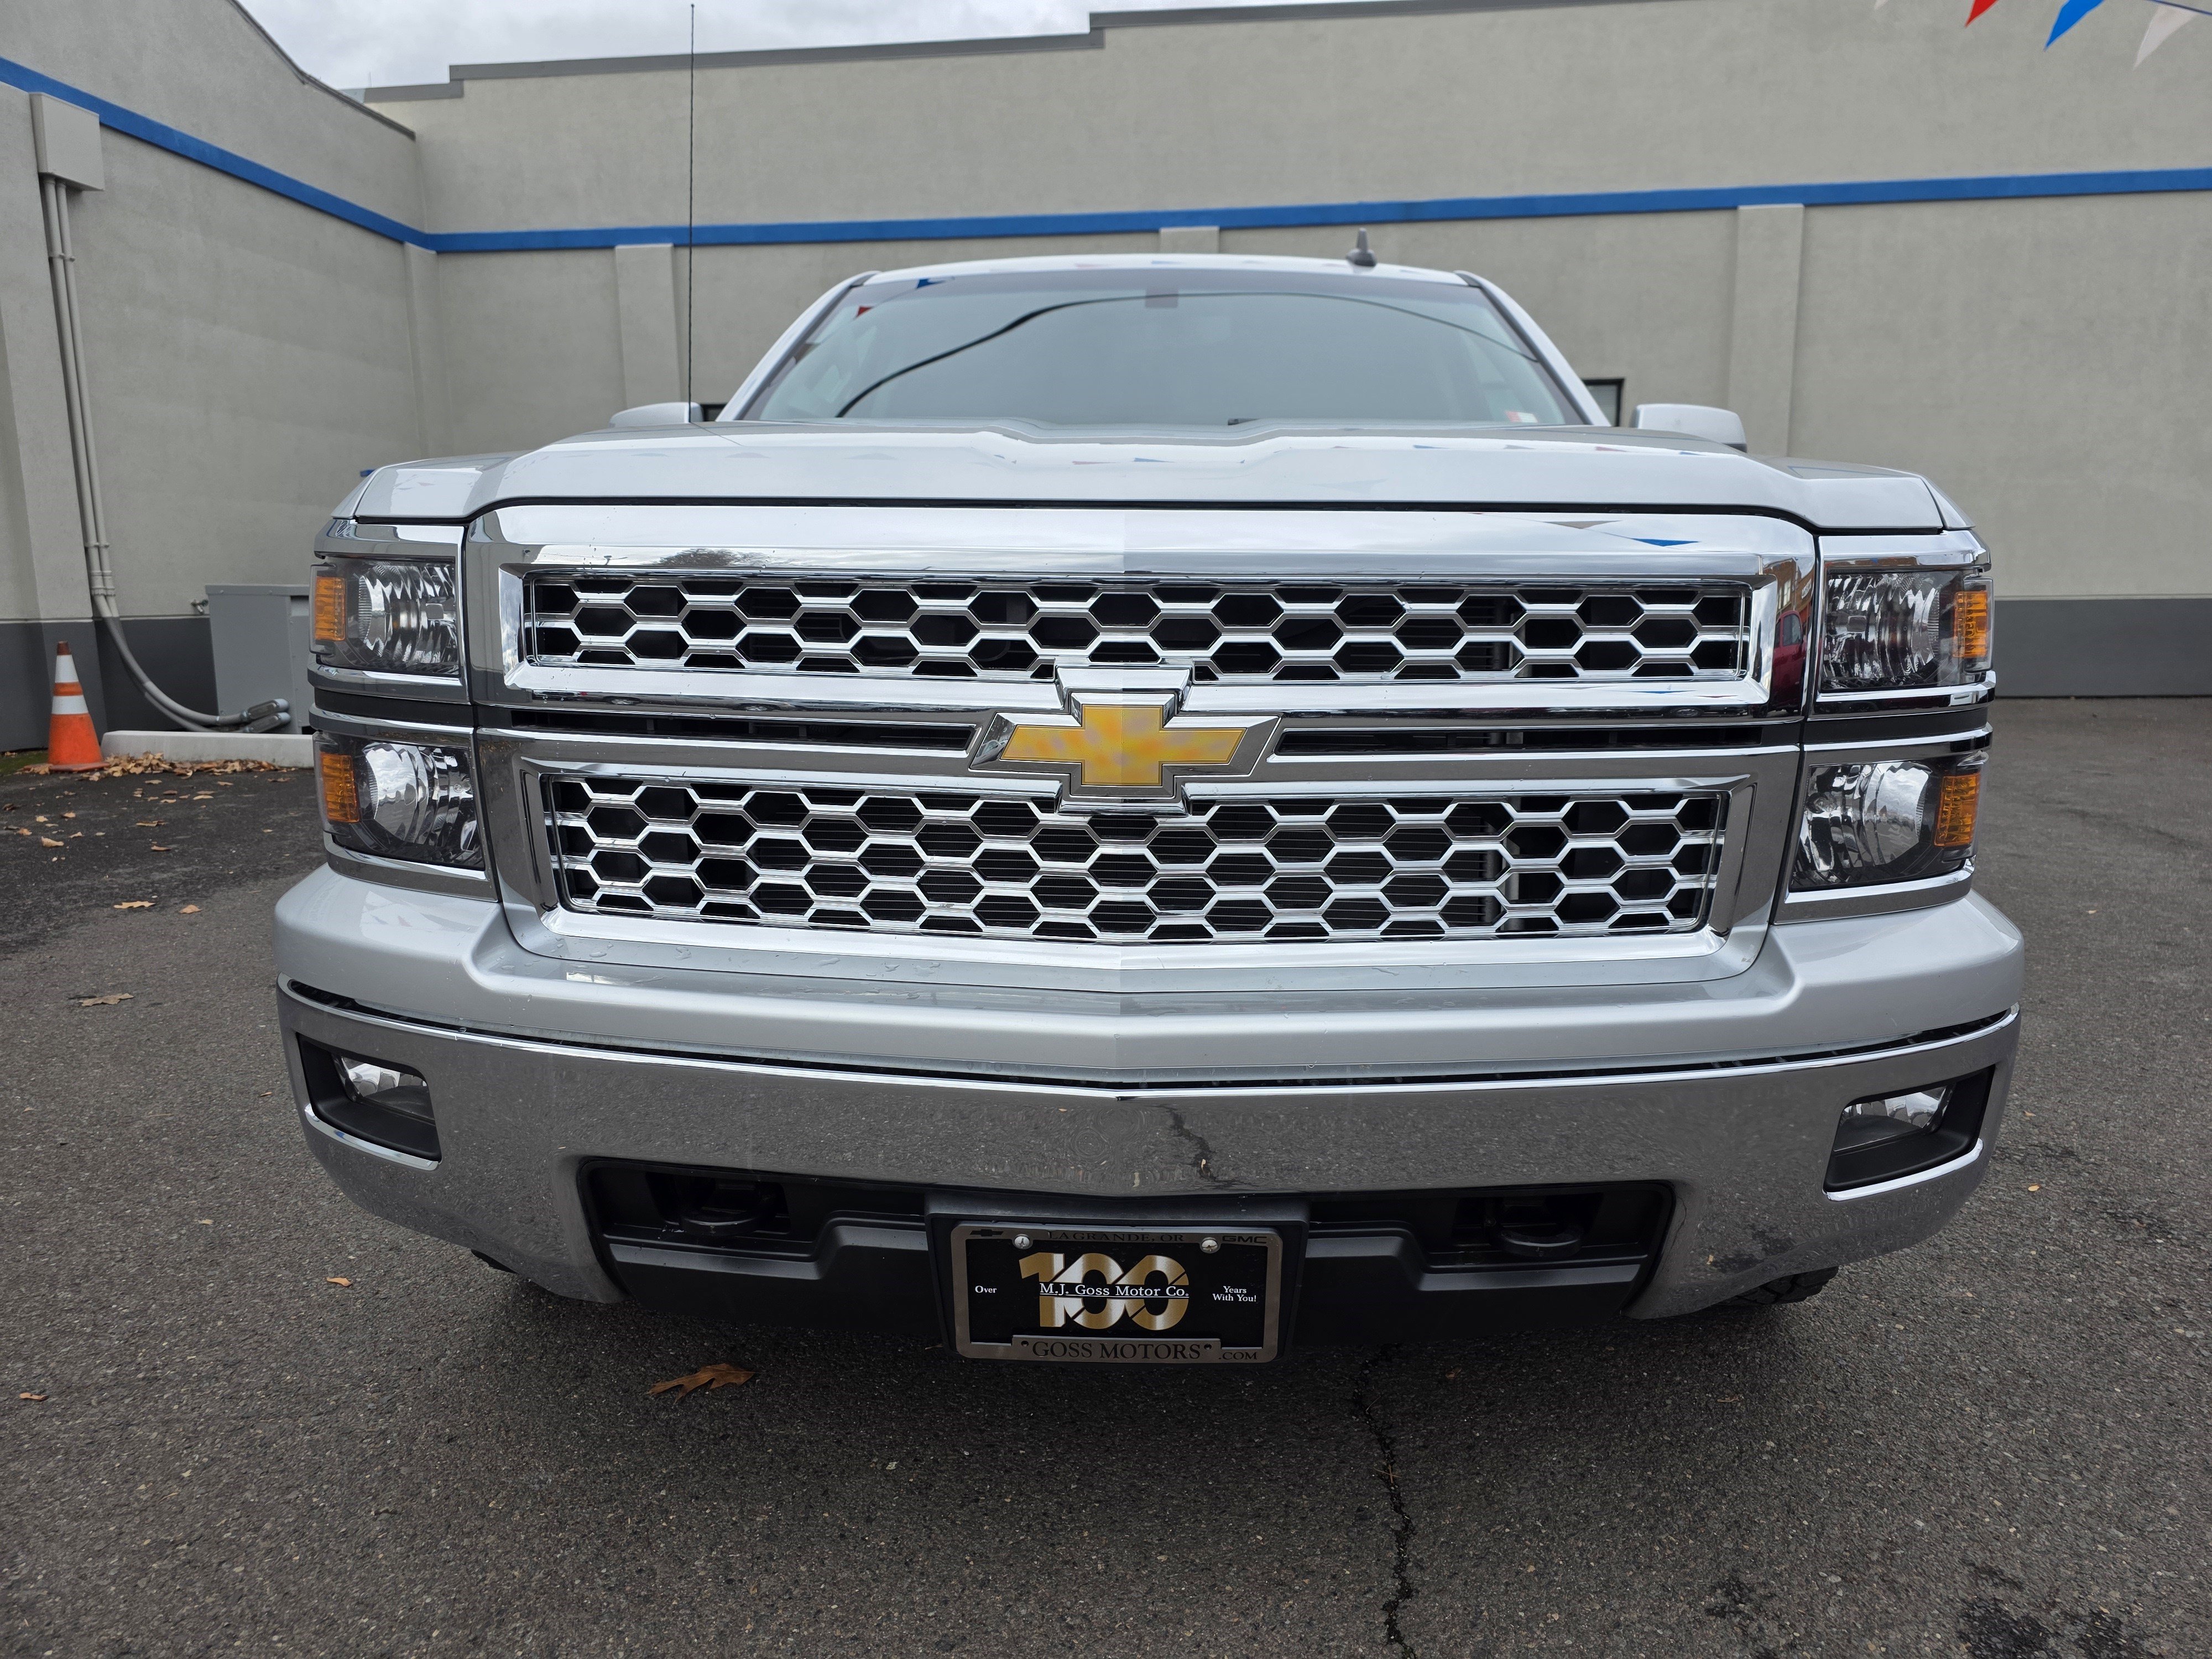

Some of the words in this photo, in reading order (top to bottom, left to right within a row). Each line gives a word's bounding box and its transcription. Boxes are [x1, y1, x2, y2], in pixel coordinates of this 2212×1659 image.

[1160, 1233, 1184, 1242] OR
[1222, 1235, 1267, 1244] GMC
[974, 1285, 997, 1293] Over
[1019, 1252, 1190, 1331] 100
[1039, 1283, 1070, 1296] M.J.
[1075, 1284, 1110, 1296] Goss
[1115, 1285, 1161, 1296] Motor
[1166, 1286, 1189, 1297] Co.
[1223, 1285, 1247, 1294] Years
[1212, 1293, 1234, 1302] With
[1236, 1294, 1257, 1302] You!
[1032, 1341, 1092, 1358] GOSS
[1099, 1342, 1201, 1360] MOTORS
[1218, 1352, 1258, 1360] .COM
